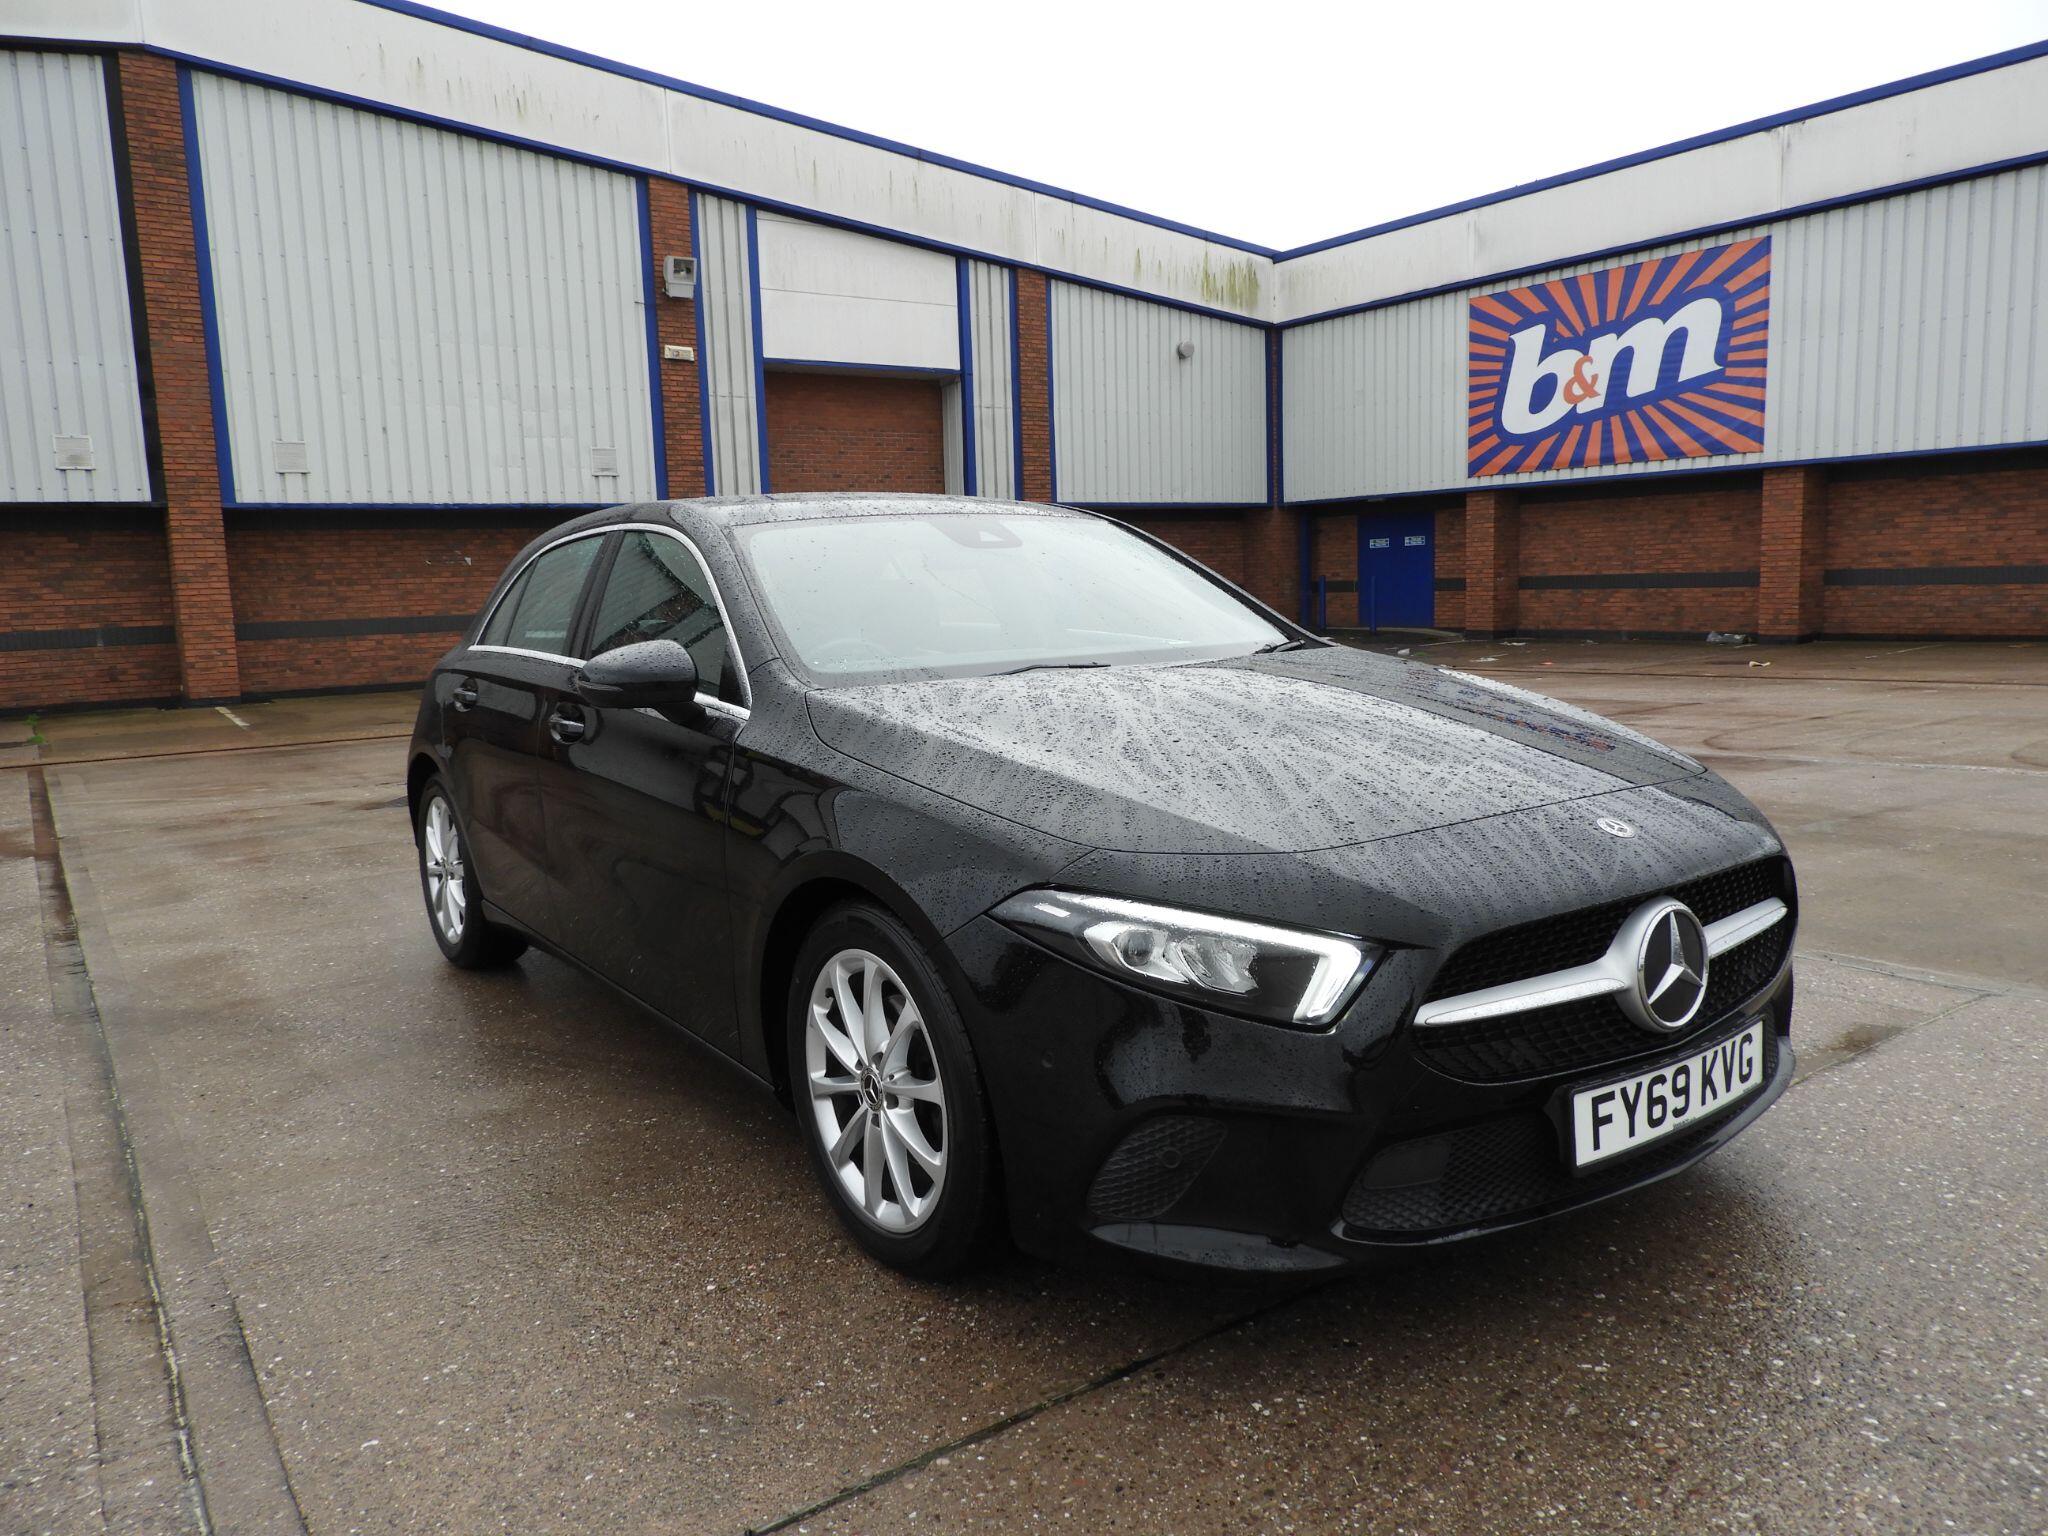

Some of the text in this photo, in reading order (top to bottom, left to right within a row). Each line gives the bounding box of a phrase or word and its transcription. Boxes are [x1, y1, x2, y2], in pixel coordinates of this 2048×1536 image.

[1501, 297, 1725, 435] b&m
[1591, 1032, 1754, 1152] FY69 KVG
